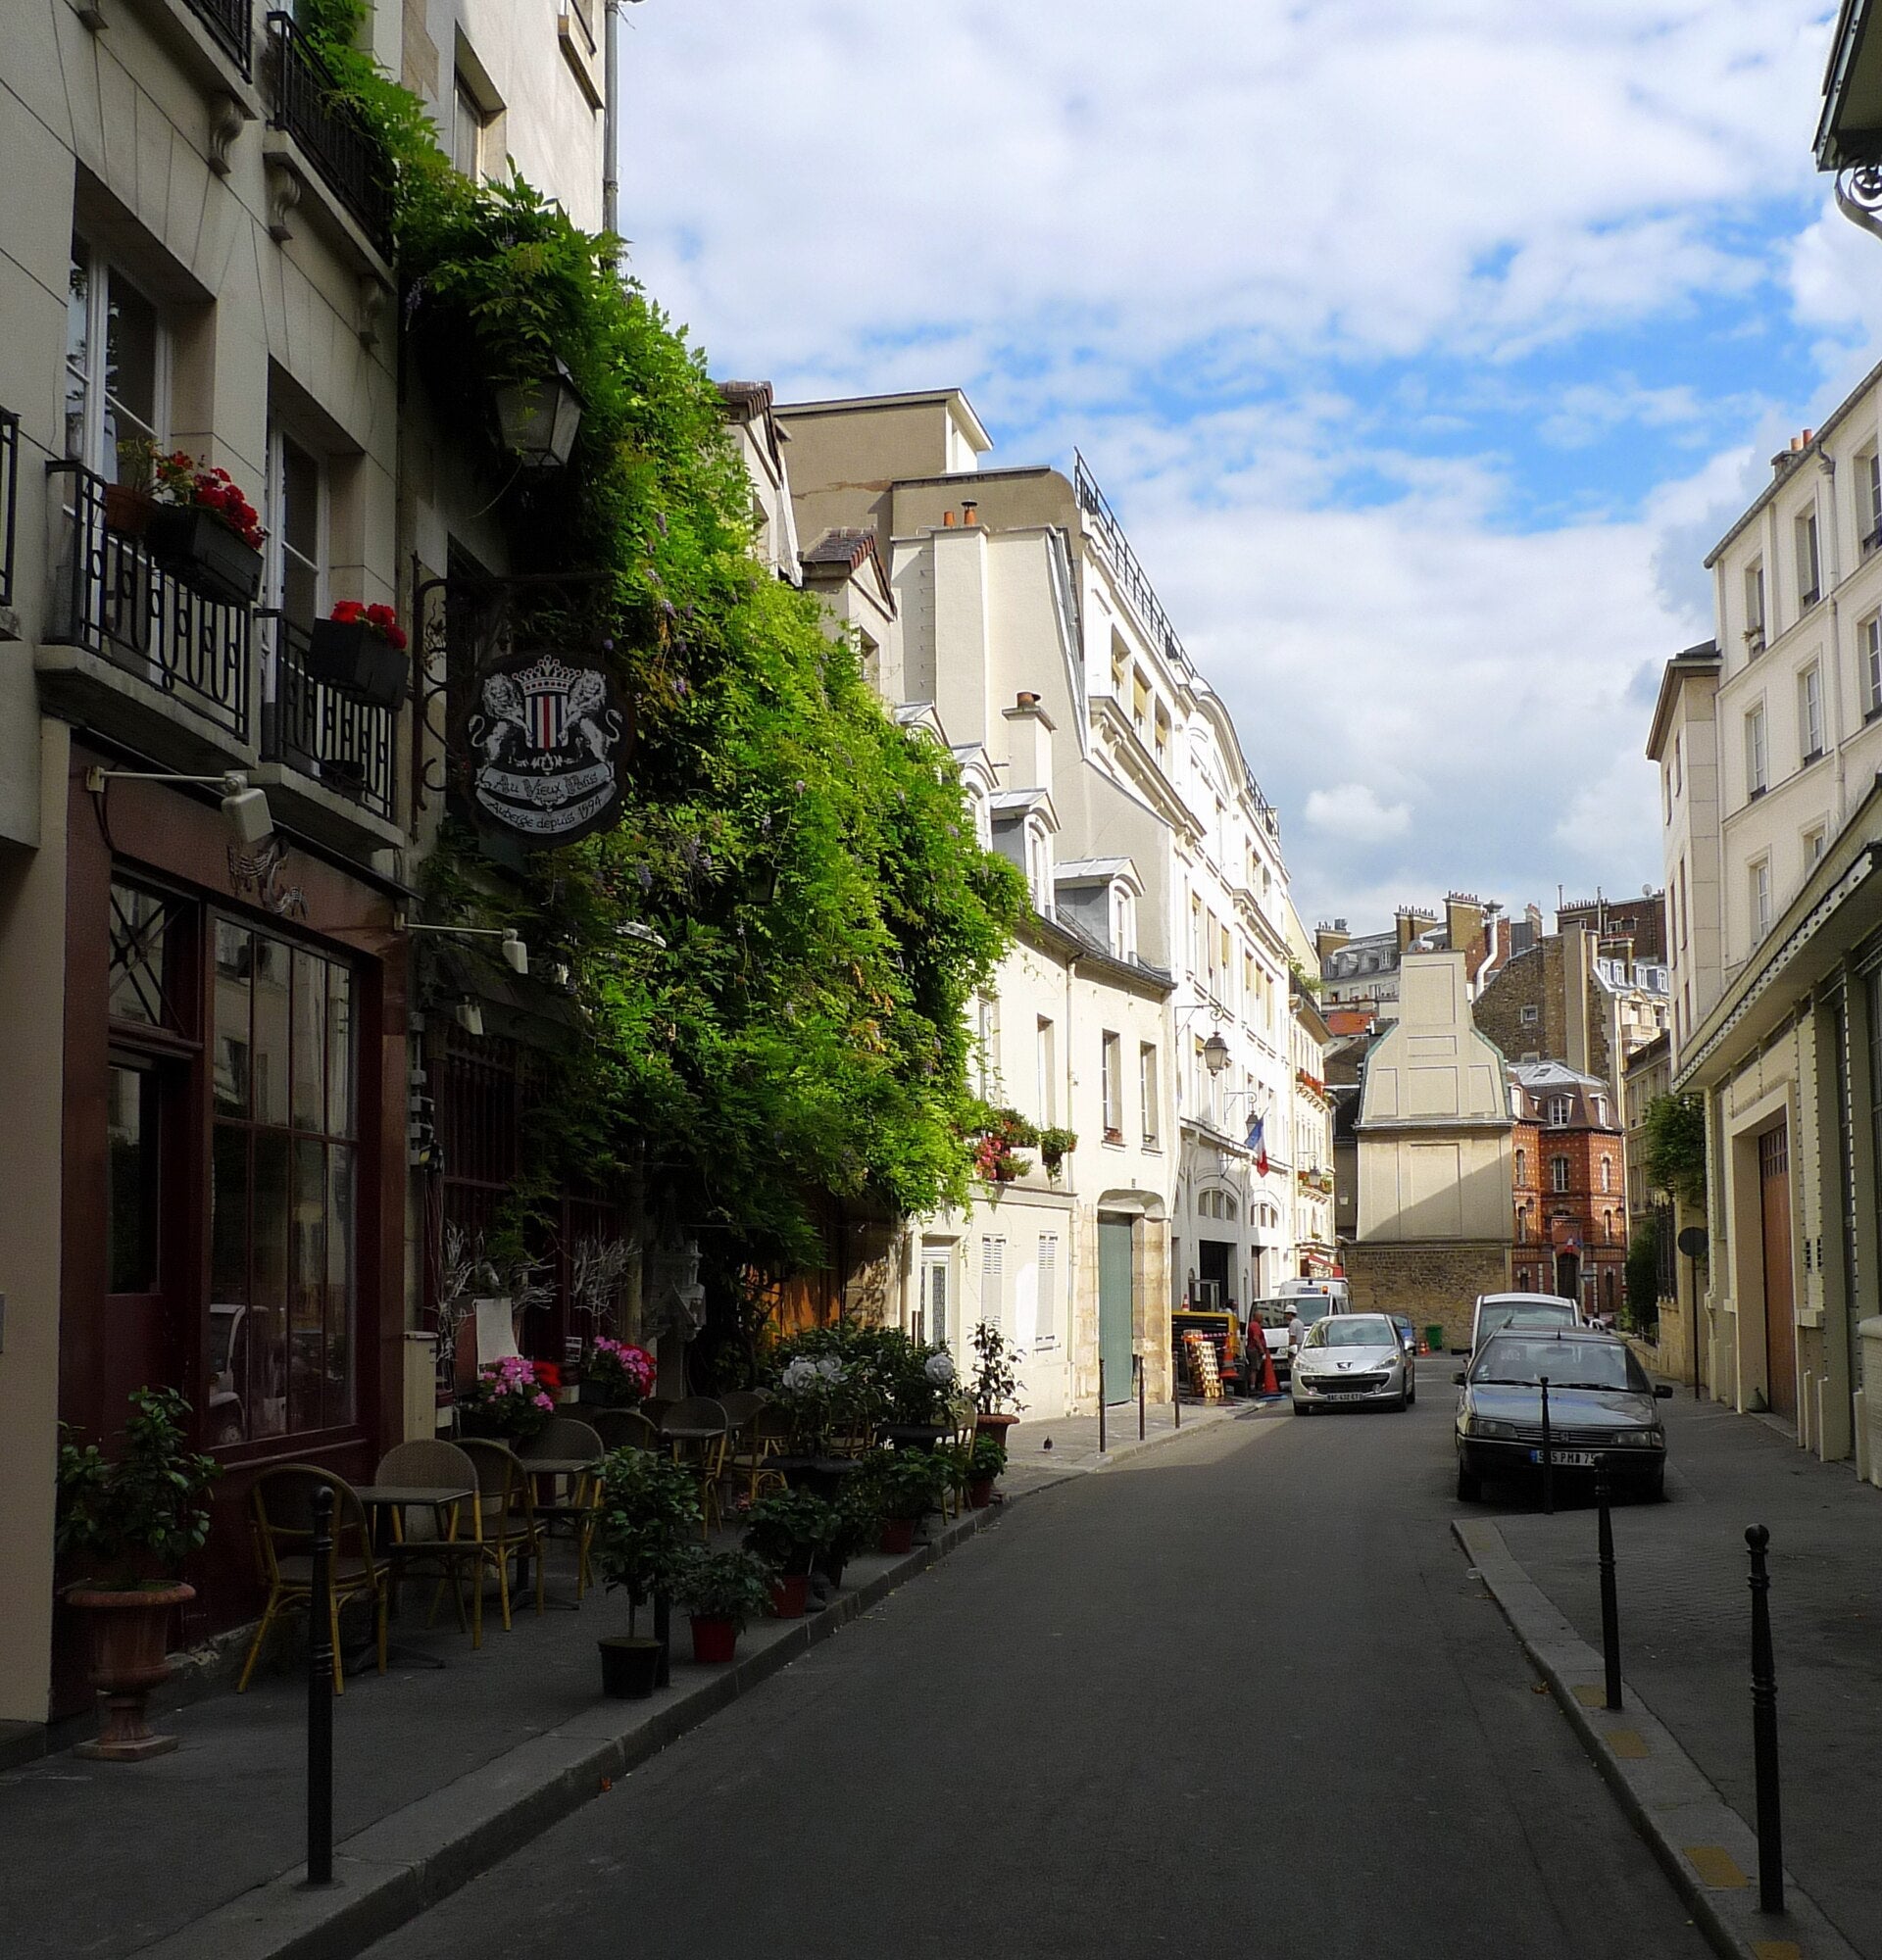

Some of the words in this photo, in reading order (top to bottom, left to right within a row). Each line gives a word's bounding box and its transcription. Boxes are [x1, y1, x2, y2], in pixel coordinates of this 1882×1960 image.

[493, 774, 519, 794] Au
[563, 772, 597, 795] Paris
[487, 802, 534, 828] Auberge
[536, 812, 574, 830] depuis
[577, 795, 603, 820] 1594
